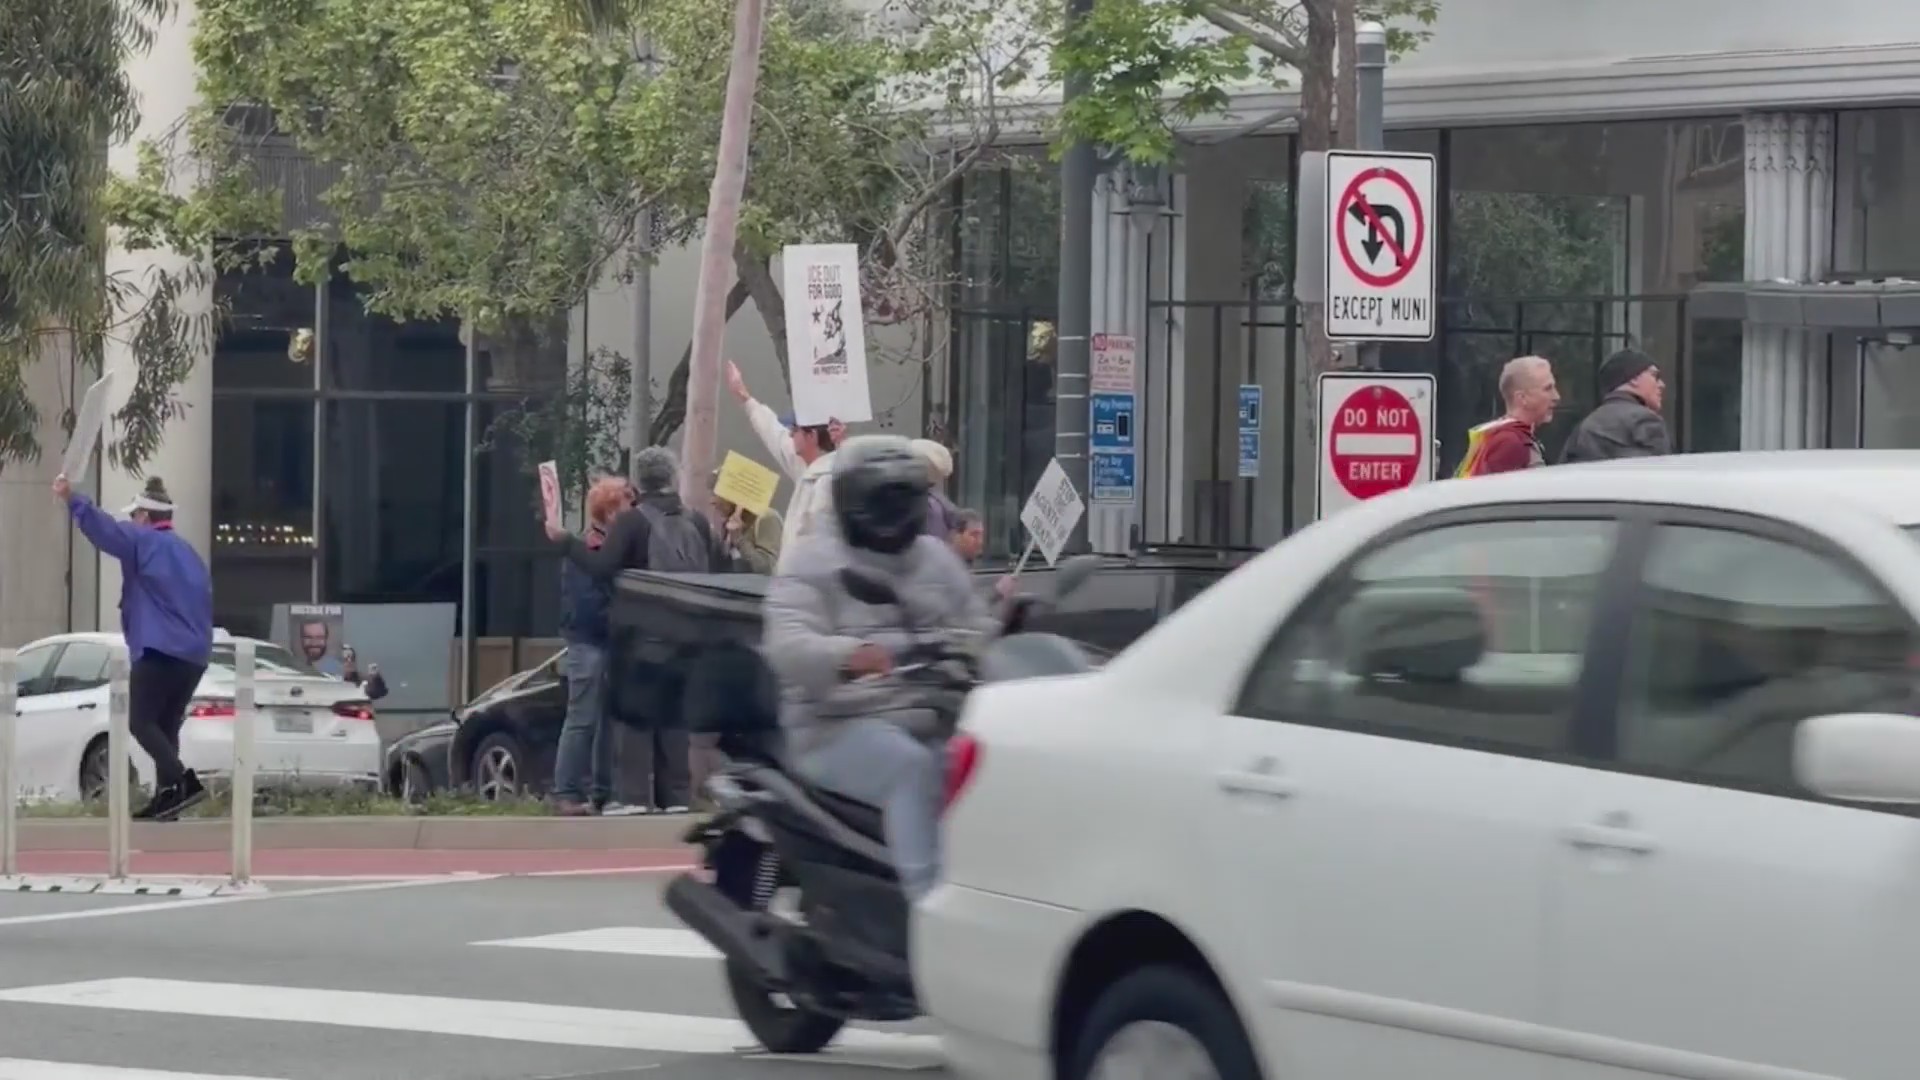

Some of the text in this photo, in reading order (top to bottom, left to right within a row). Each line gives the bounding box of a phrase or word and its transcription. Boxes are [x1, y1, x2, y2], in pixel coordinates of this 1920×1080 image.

[807, 264, 841, 282] ICE OUT
[808, 283, 842, 299] FOR GOOD
[1333, 295, 1426, 321] EXCEPT MUNI
[1108, 339, 1135, 351] PARKING
[1094, 398, 1132, 412] Pay here
[1343, 407, 1410, 428] DO NOT
[1111, 455, 1123, 467] by
[1349, 461, 1402, 481] ENTER
[325, 604, 342, 615] FOR
